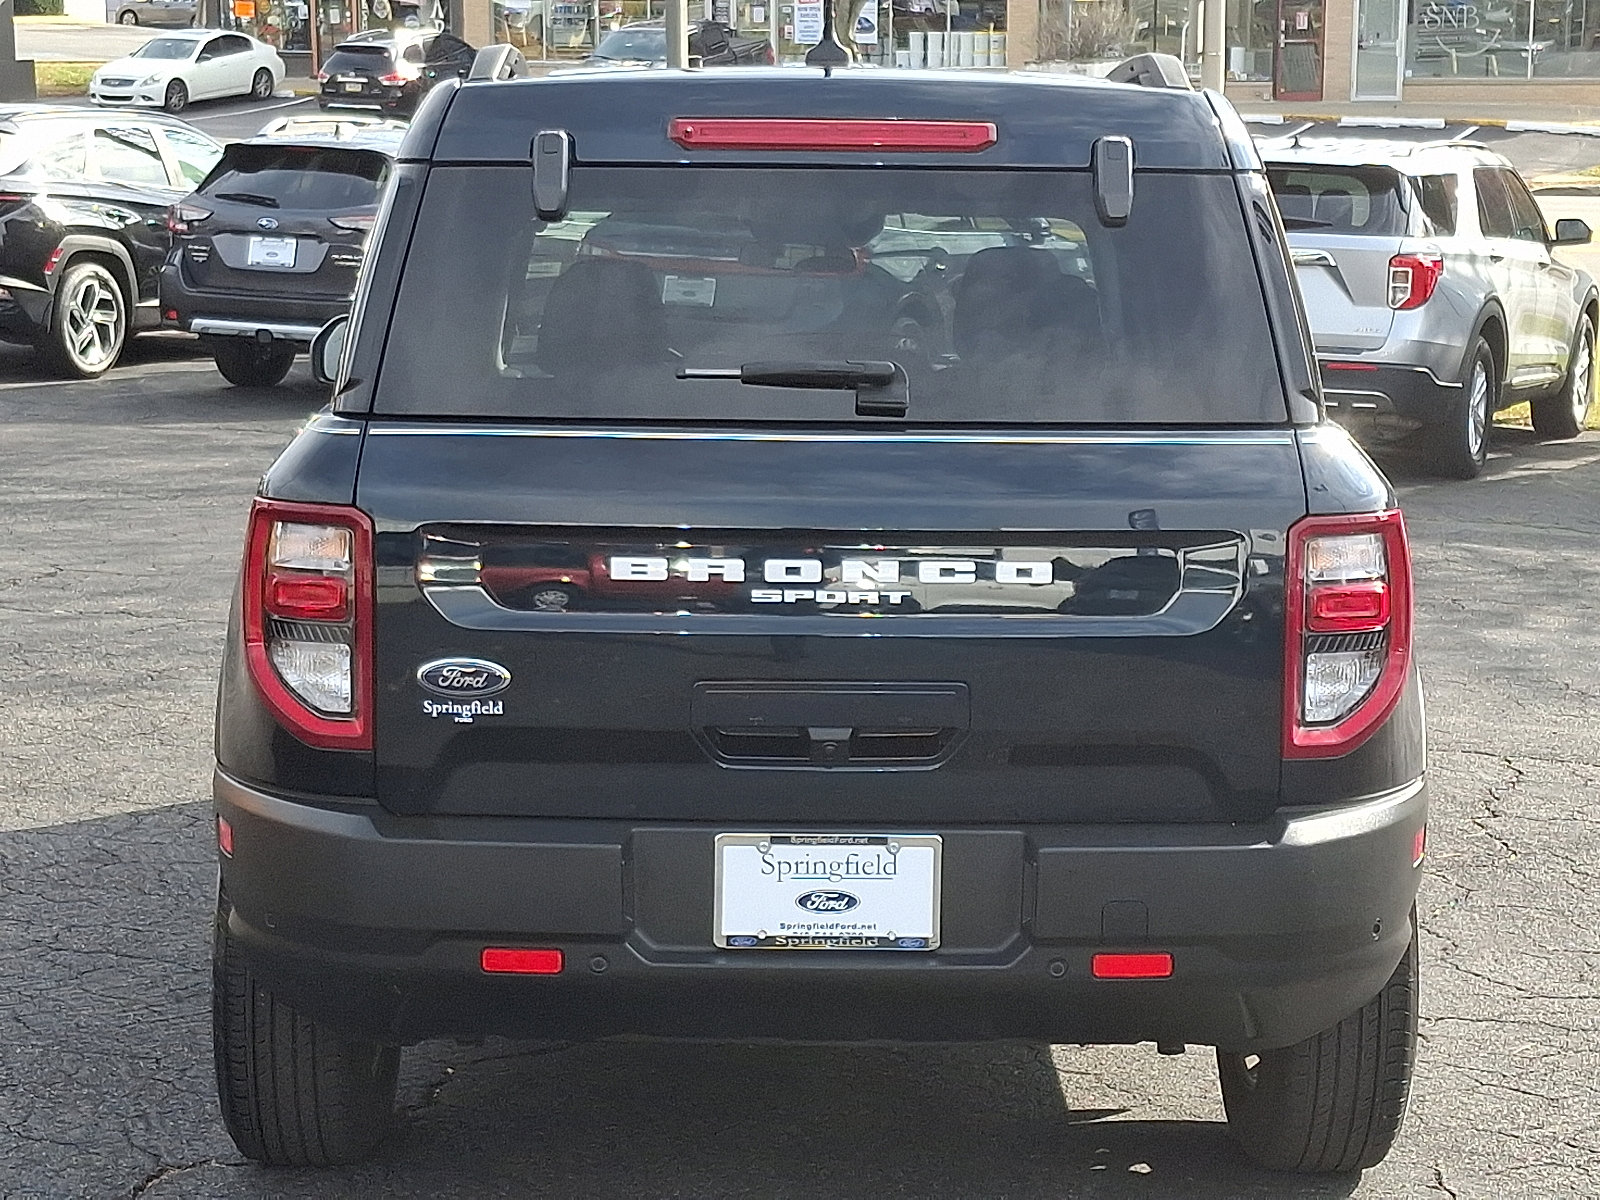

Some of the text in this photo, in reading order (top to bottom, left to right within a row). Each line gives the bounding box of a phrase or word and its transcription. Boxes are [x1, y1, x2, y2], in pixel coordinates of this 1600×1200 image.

[609, 555, 1054, 585] BRONCO
[750, 589, 913, 605] SPORT
[438, 666, 489, 689] Ford
[422, 700, 505, 718] Springfield
[760, 853, 898, 882] Springfield
[806, 892, 850, 911] Ford
[779, 922, 878, 931] SpringfieldFord.net
